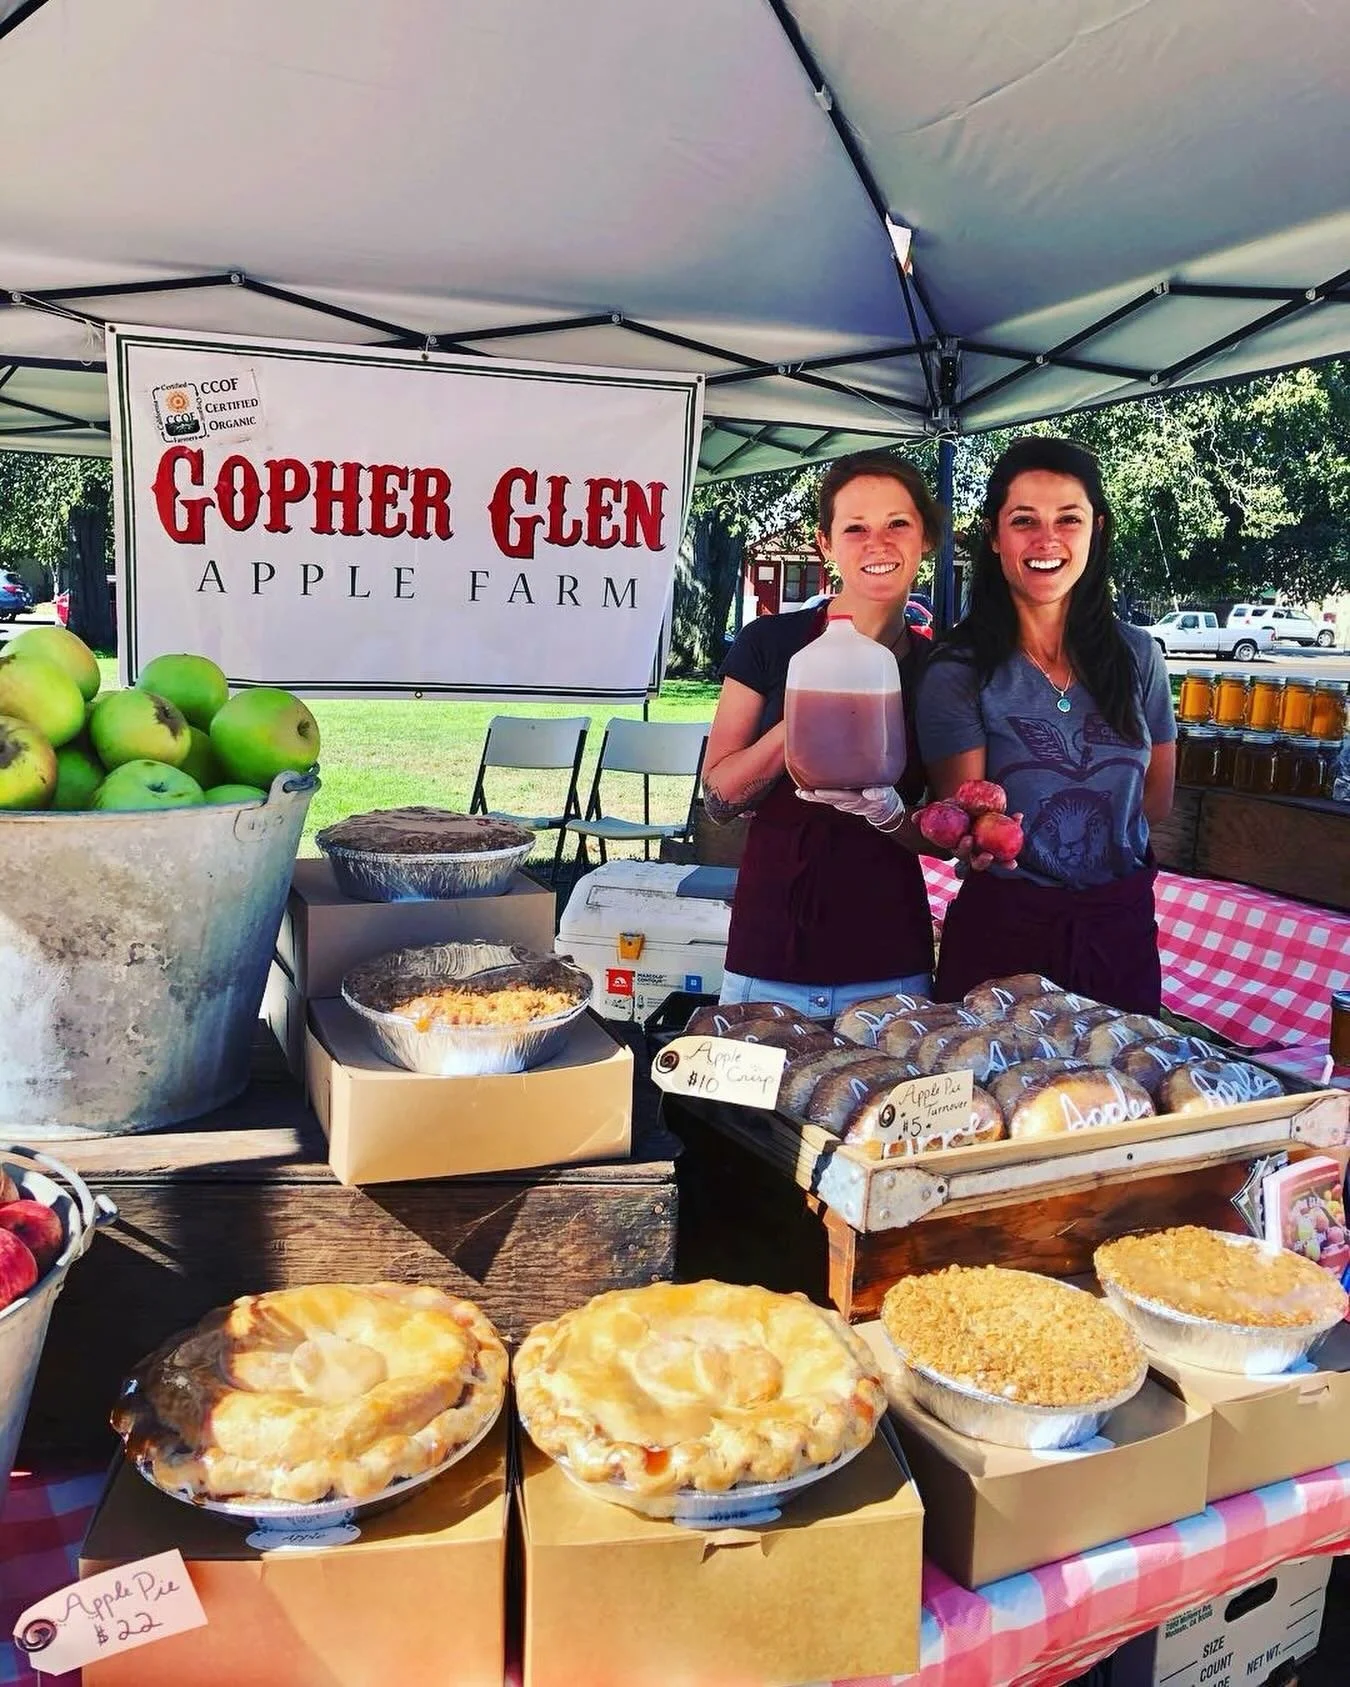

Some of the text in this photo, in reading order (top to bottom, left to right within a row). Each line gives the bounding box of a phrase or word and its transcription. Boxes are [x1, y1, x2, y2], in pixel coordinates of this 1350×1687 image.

[200, 377, 238, 395] CCOF
[166, 411, 196, 424] CCOF
[197, 559, 638, 609] APPLE FARM
[684, 1040, 742, 1068] Apple
[687, 1070, 720, 1093] $10
[898, 1077, 961, 1108] Apple Pie
[925, 1101, 968, 1117] Turnover
[57, 1571, 180, 1622] Apple Pie
[94, 1612, 162, 1646] $22
[1202, 1635, 1225, 1659] SIZE
[1200, 1652, 1234, 1682] COUNT
[1246, 1654, 1265, 1676] NET
